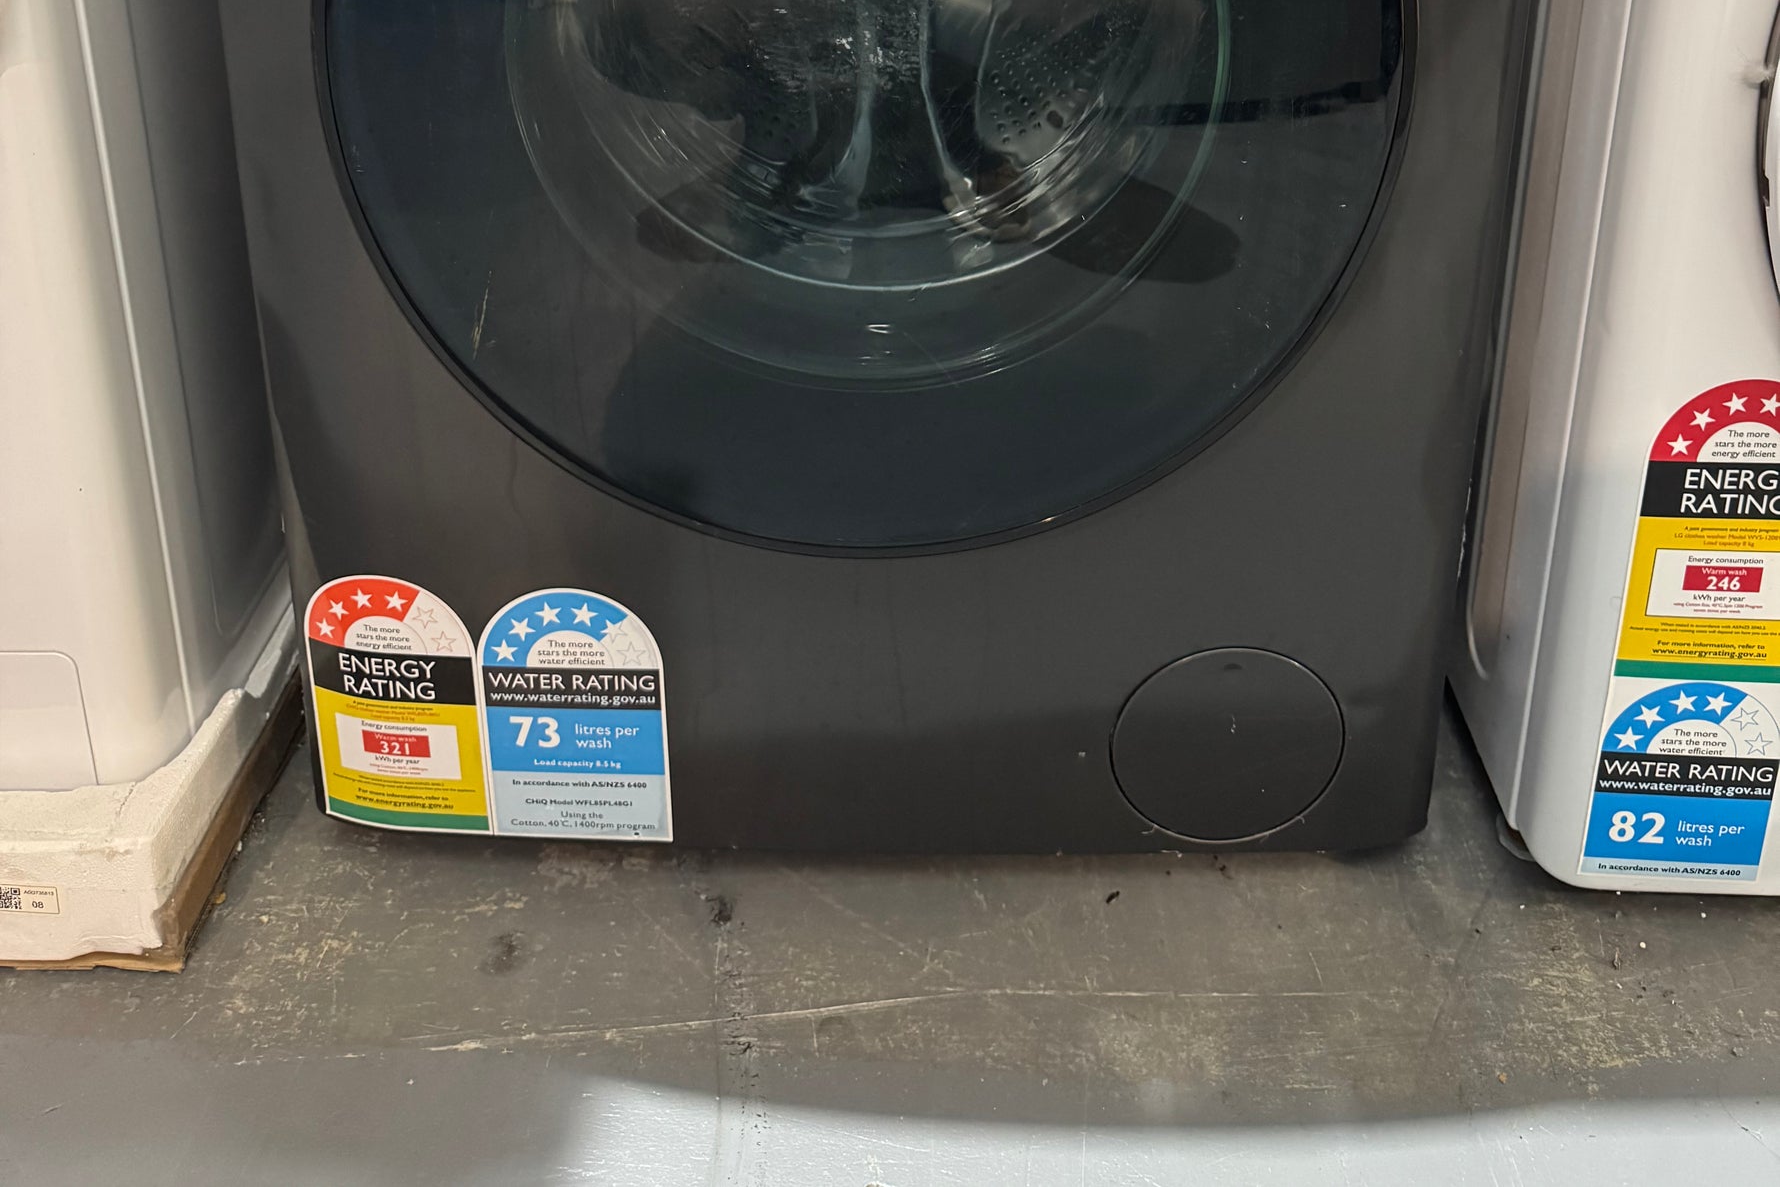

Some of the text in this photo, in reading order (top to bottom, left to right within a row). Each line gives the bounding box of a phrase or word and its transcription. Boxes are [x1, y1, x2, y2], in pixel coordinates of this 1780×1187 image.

[1728, 430, 1744, 438] The
[1712, 450, 1776, 459] energy efficient
[1688, 556, 1714, 564] Energy
[1702, 567, 1726, 575] Warm
[1706, 576, 1741, 590] 246
[364, 624, 378, 632] The
[356, 641, 381, 650] energy
[548, 640, 566, 648] The
[1693, 641, 1736, 649] information,
[1652, 648, 1767, 660] www.energyrating.gov.au
[339, 653, 436, 679] ENERGY
[489, 672, 655, 691] WATER RATING
[344, 674, 436, 700] RATING
[491, 692, 656, 706] www.waterrating.gov.au
[361, 720, 383, 730] Energy
[509, 716, 561, 748] 73
[575, 724, 640, 739] litres per
[1674, 729, 1692, 737] The
[375, 733, 397, 741] Warm
[1685, 738, 1700, 746] the
[380, 741, 410, 755] 321
[576, 737, 612, 749] wash
[1688, 748, 1723, 756] efficient
[558, 760, 594, 768] capacity
[610, 761, 621, 769] kg
[1604, 760, 1774, 782] WATER RATING
[523, 779, 570, 787] accordance
[1599, 780, 1771, 797] www.waterrating.gov.au
[356, 795, 454, 810] www.energyrating.gov.au
[561, 811, 587, 820] Using
[574, 821, 614, 829] 1400rpm
[617, 823, 656, 831] program
[1608, 810, 1666, 844] 82
[1678, 820, 1745, 837] litres per
[1675, 835, 1712, 846] wash
[1609, 864, 1659, 873] accordance
[1661, 866, 1680, 874] with
[1681, 867, 1718, 876] AS/NZS
[32, 901, 44, 909] 08
